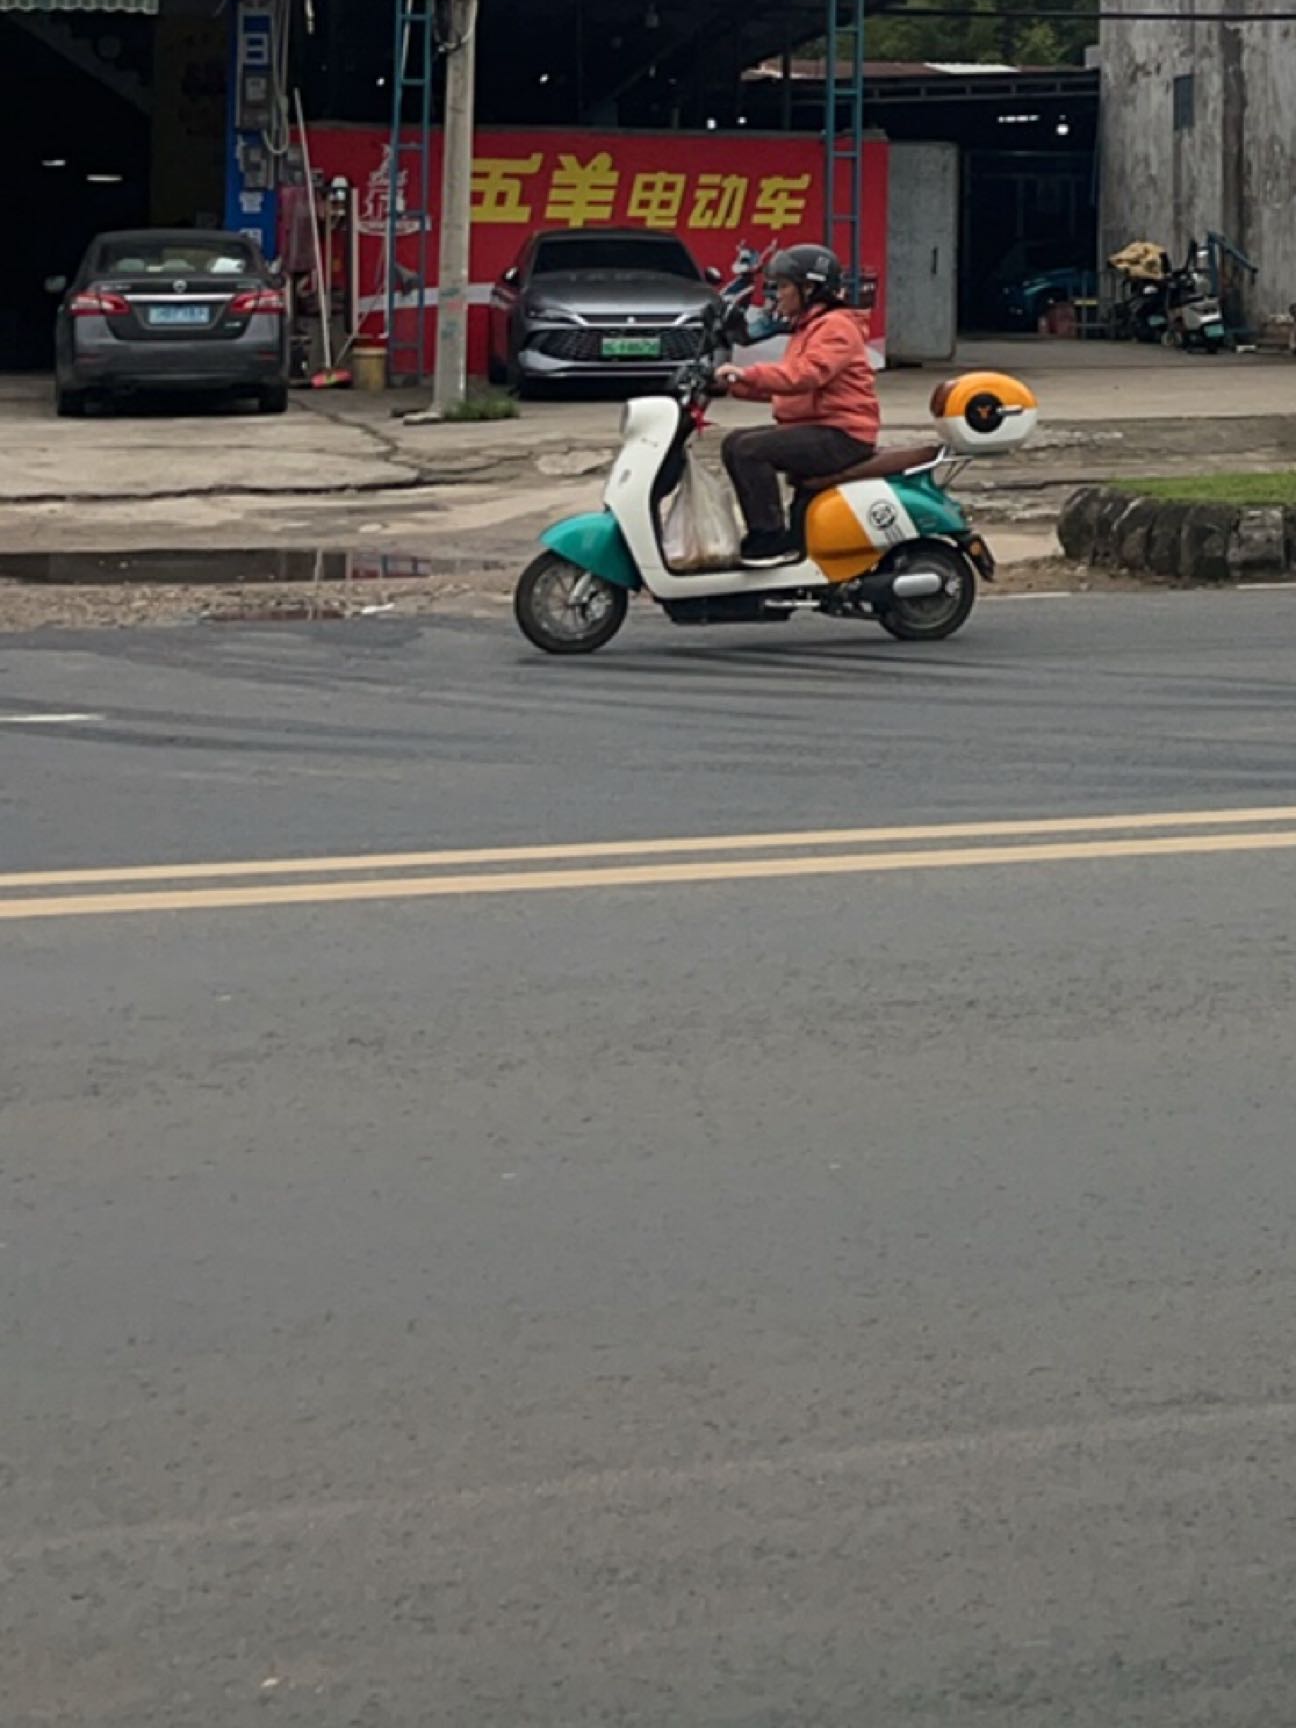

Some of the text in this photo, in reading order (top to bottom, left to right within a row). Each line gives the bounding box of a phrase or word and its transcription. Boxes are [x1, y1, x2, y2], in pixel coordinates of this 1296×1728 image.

[471, 152, 811, 231] 五羊电动车
